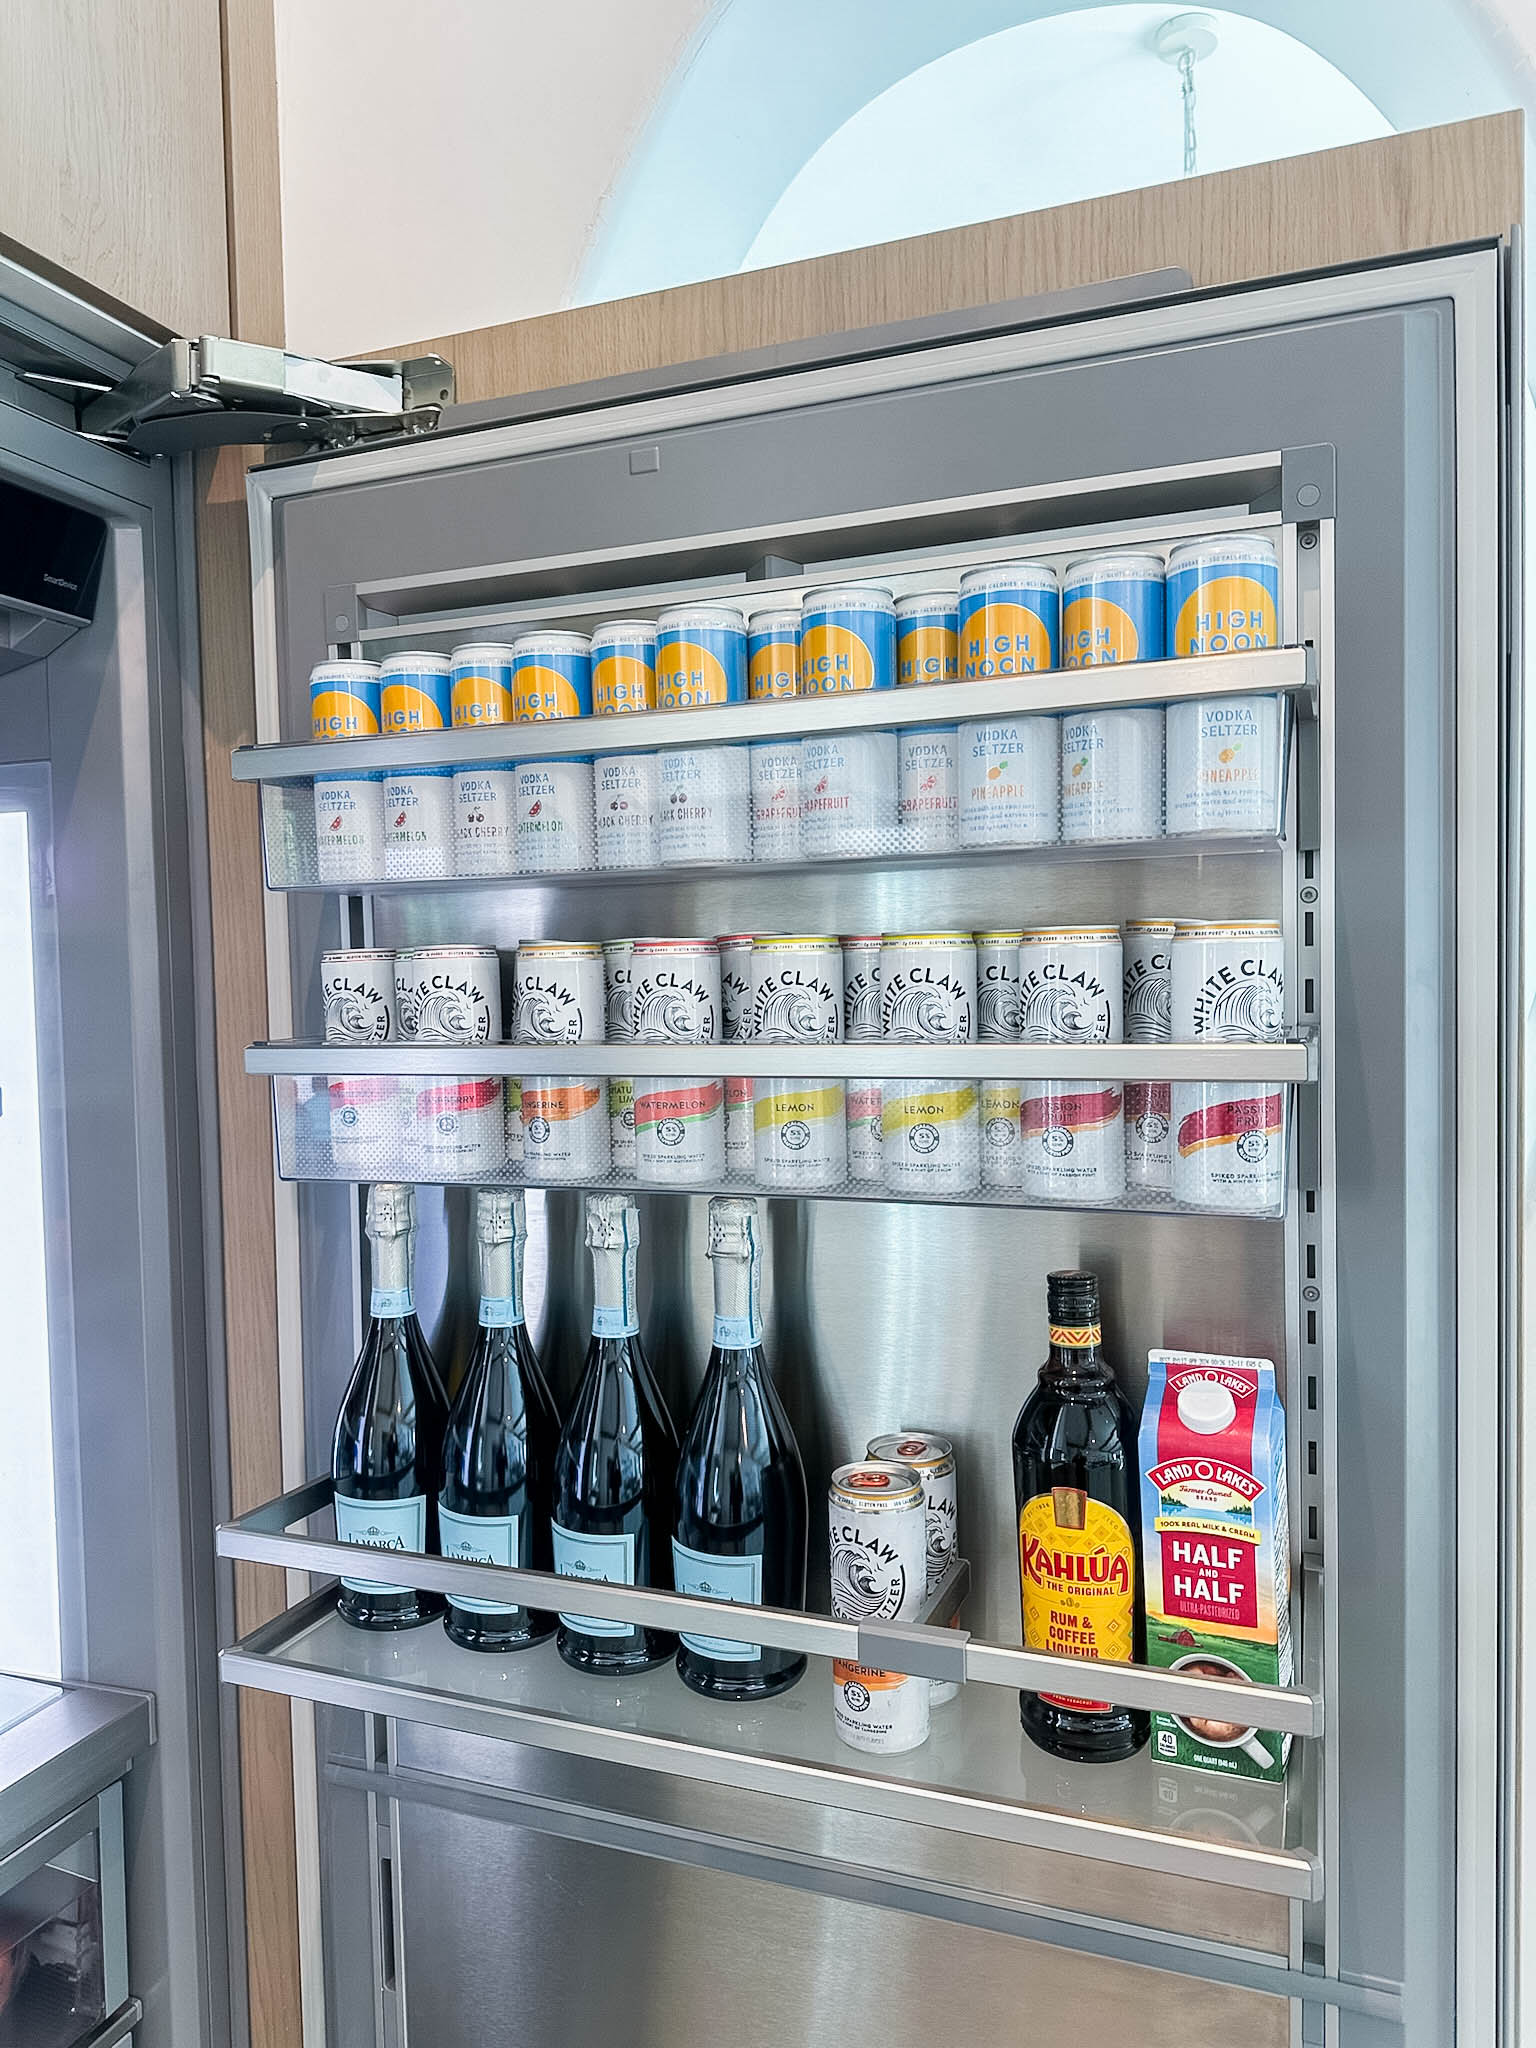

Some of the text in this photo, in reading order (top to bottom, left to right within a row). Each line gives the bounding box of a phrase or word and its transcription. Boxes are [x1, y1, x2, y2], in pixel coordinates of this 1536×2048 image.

[1196, 610, 1264, 631] HIGH
[968, 634, 1031, 658] HIGH
[1189, 633, 1268, 654] NOON
[901, 656, 958, 677] HIGH
[965, 656, 1036, 678] NOON
[596, 684, 643, 702] HIGH
[454, 703, 499, 720] HIGH
[1205, 709, 1254, 722] VODKA
[976, 728, 1018, 743] VODKA
[1201, 723, 1258, 737] SELTZER
[908, 744, 948, 758] VODKA
[972, 743, 1025, 758] SELTZER
[761, 756, 797, 769] VODKA
[905, 757, 953, 771] SELTZER
[602, 766, 636, 778] VODKA
[758, 768, 802, 781] SELTZER
[460, 780, 492, 791] VODKA
[601, 778, 641, 791] SELTZER
[971, 784, 1025, 800] PINEAPPLE
[459, 792, 497, 803] SELTZER
[902, 796, 958, 813] GRAPEFRUIT
[677, 807, 712, 821] CHERRY
[333, 977, 383, 1004] CLAW
[431, 975, 485, 1004] CLAW
[525, 976, 576, 1007] CLAW
[633, 979, 653, 1036] WHITE
[655, 972, 709, 1004] CLAW
[754, 977, 778, 1036] WHITE
[780, 970, 834, 1002] CLAW
[882, 974, 907, 1036] WHITE
[909, 967, 966, 1001] CLAW
[1019, 970, 1040, 1034] WHITE
[1042, 964, 1105, 998] CLAW
[1193, 966, 1236, 1035] WHITE
[640, 1100, 706, 1110] WATERMELON
[775, 1103, 815, 1112] LEMON
[904, 1105, 944, 1115] LEMON
[981, 1099, 1020, 1109] LEMON
[1175, 1373, 1206, 1388] LAND
[1220, 1374, 1250, 1395] LAKES
[1155, 1461, 1259, 1496] LAND O LAKES
[1181, 1521, 1200, 1529] REAL
[1202, 1523, 1220, 1531] MILK
[1228, 1527, 1256, 1539] CREAM
[842, 1525, 899, 1565] CLAW
[1022, 1533, 1129, 1594] KAHLÚA
[1172, 1540, 1243, 1570] HALF
[1198, 1567, 1219, 1579] AND
[1047, 1580, 1115, 1596] THE ORIGINAL
[1173, 1574, 1244, 1605] HALF
[1179, 1600, 1240, 1621] ULTRA-PASTEURIZED
[1050, 1610, 1093, 1629] RUM &
[1050, 1627, 1096, 1645] COFFEE
[844, 1715, 872, 1729] SPARKLING
[1162, 1733, 1173, 1745] 40
